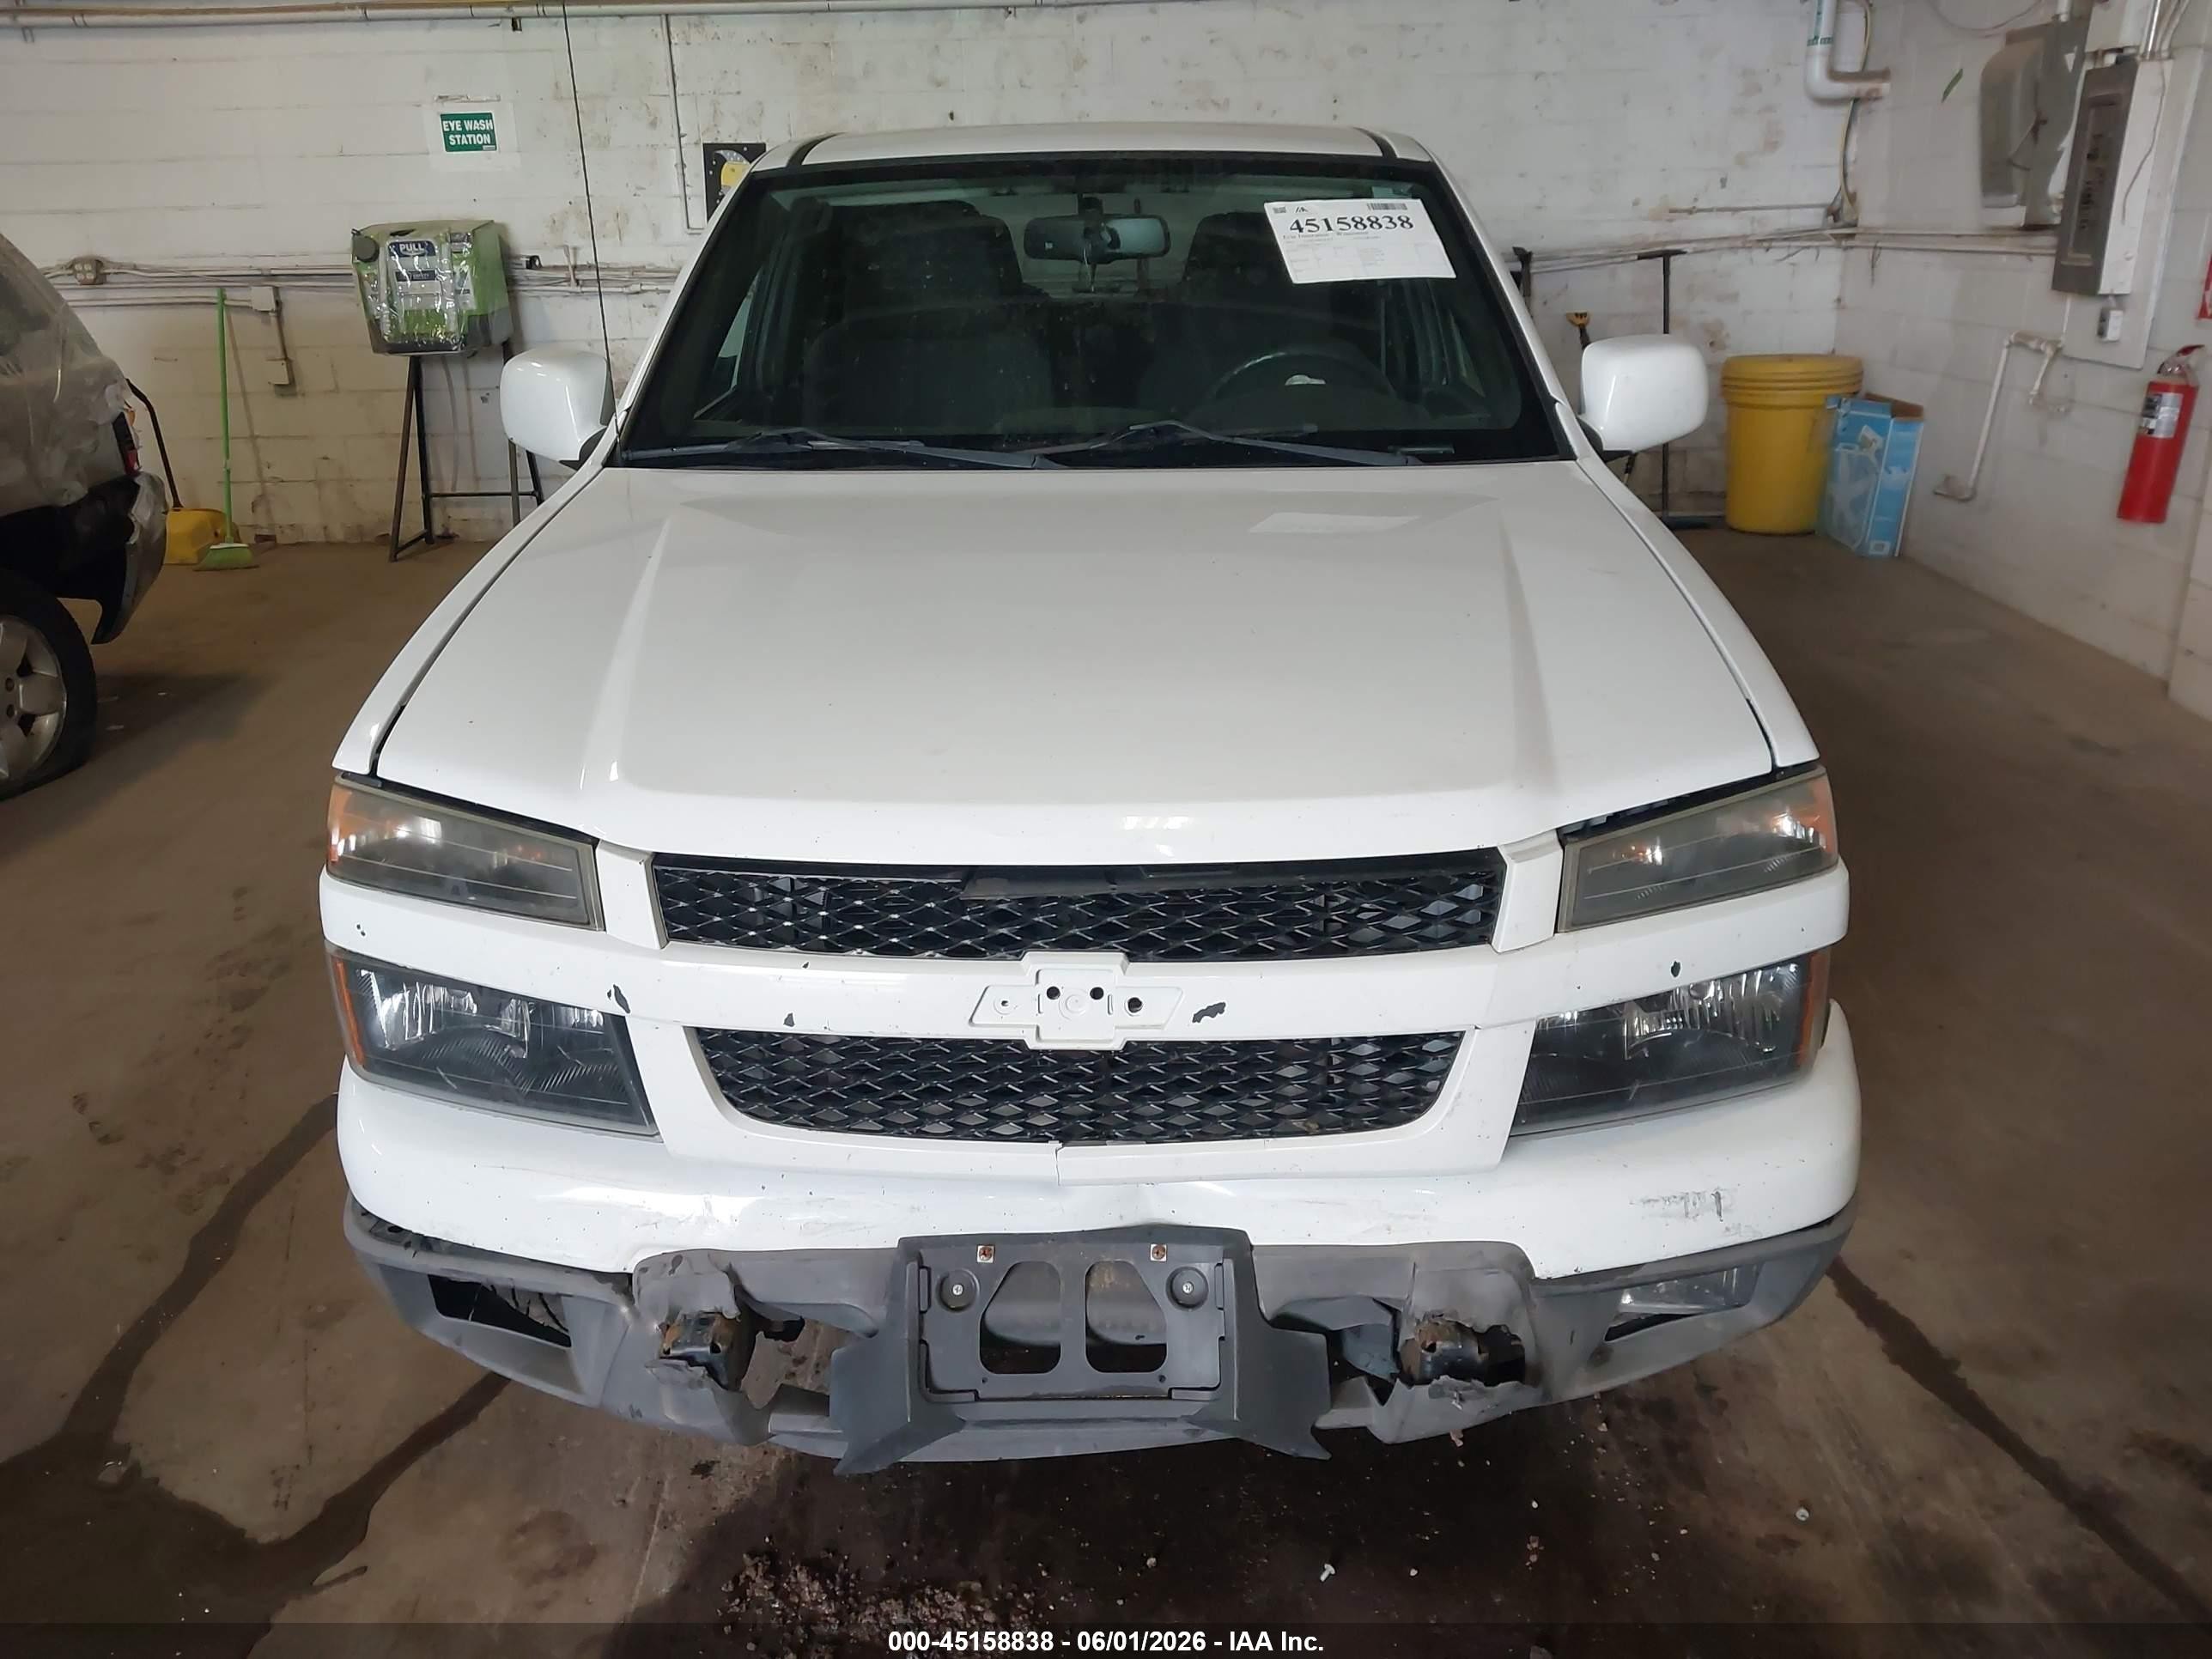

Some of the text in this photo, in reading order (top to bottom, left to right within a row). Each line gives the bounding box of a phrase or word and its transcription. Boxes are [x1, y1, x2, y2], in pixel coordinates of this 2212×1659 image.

[442, 118, 493, 131] EYE WASH
[448, 133, 491, 145] STATION
[1290, 215, 1414, 234] 45158838
[398, 243, 425, 252] PULL
